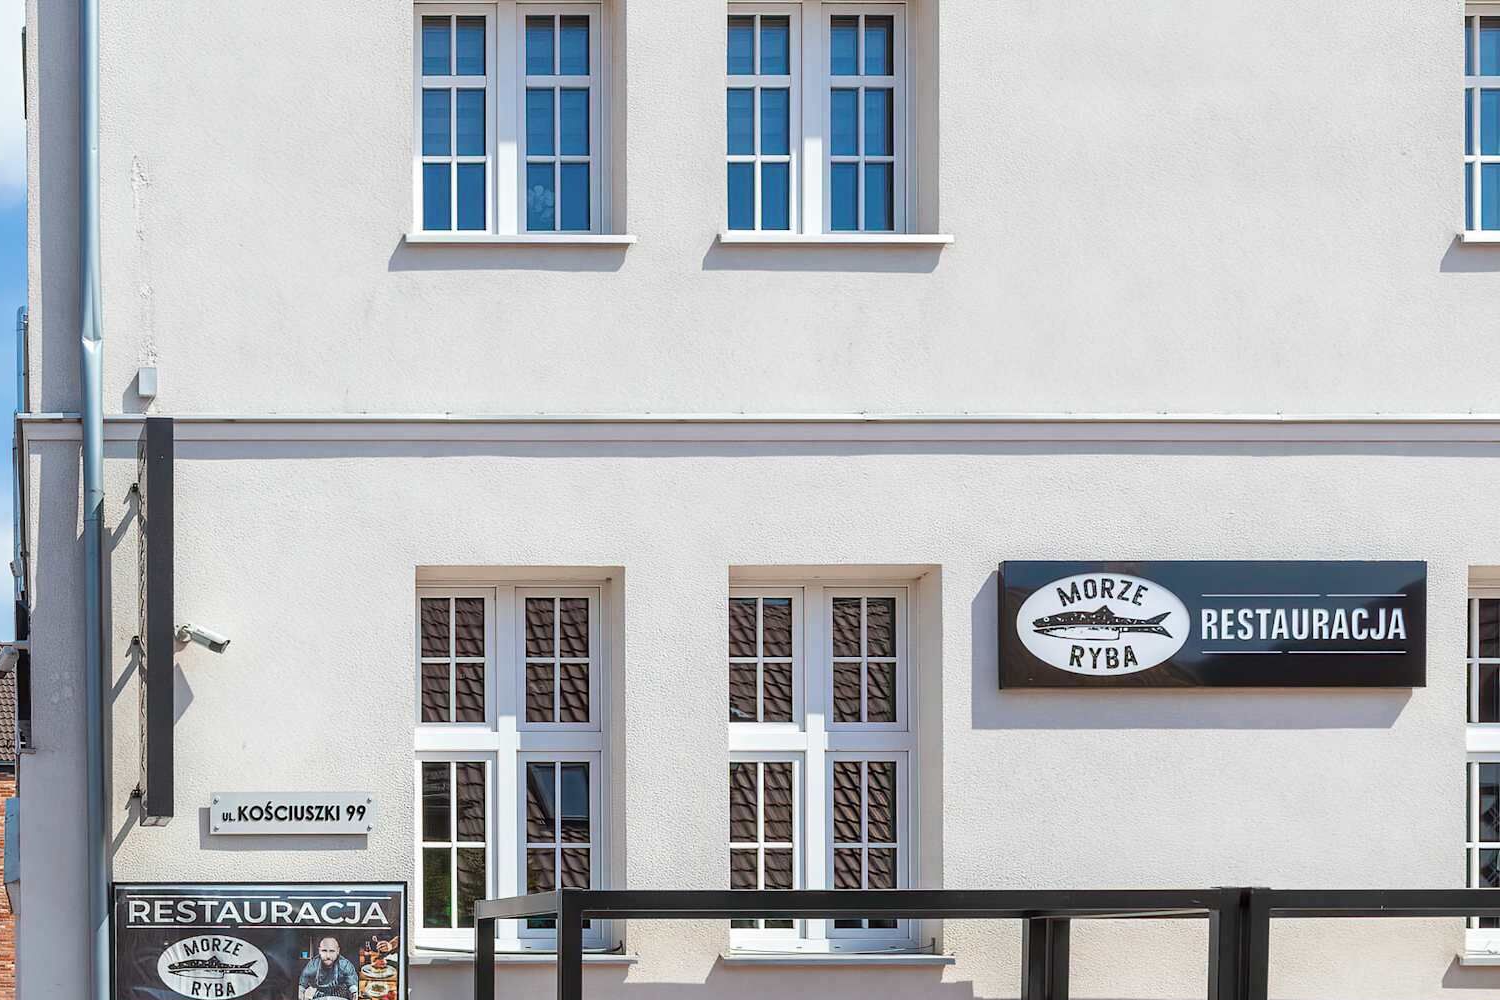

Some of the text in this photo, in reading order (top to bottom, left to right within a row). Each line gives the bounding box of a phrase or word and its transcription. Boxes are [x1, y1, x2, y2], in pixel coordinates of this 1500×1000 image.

[1056, 578, 1149, 607] MORZE
[1201, 607, 1407, 641] RESTAURACJA
[1069, 645, 1139, 669] RYBA
[237, 801, 340, 822] KOŚCIUSZKI
[346, 805, 366, 822] 99
[128, 900, 389, 925] RESTAURACJA
[183, 938, 244, 957] MORZE
[191, 981, 236, 998] RYBA
